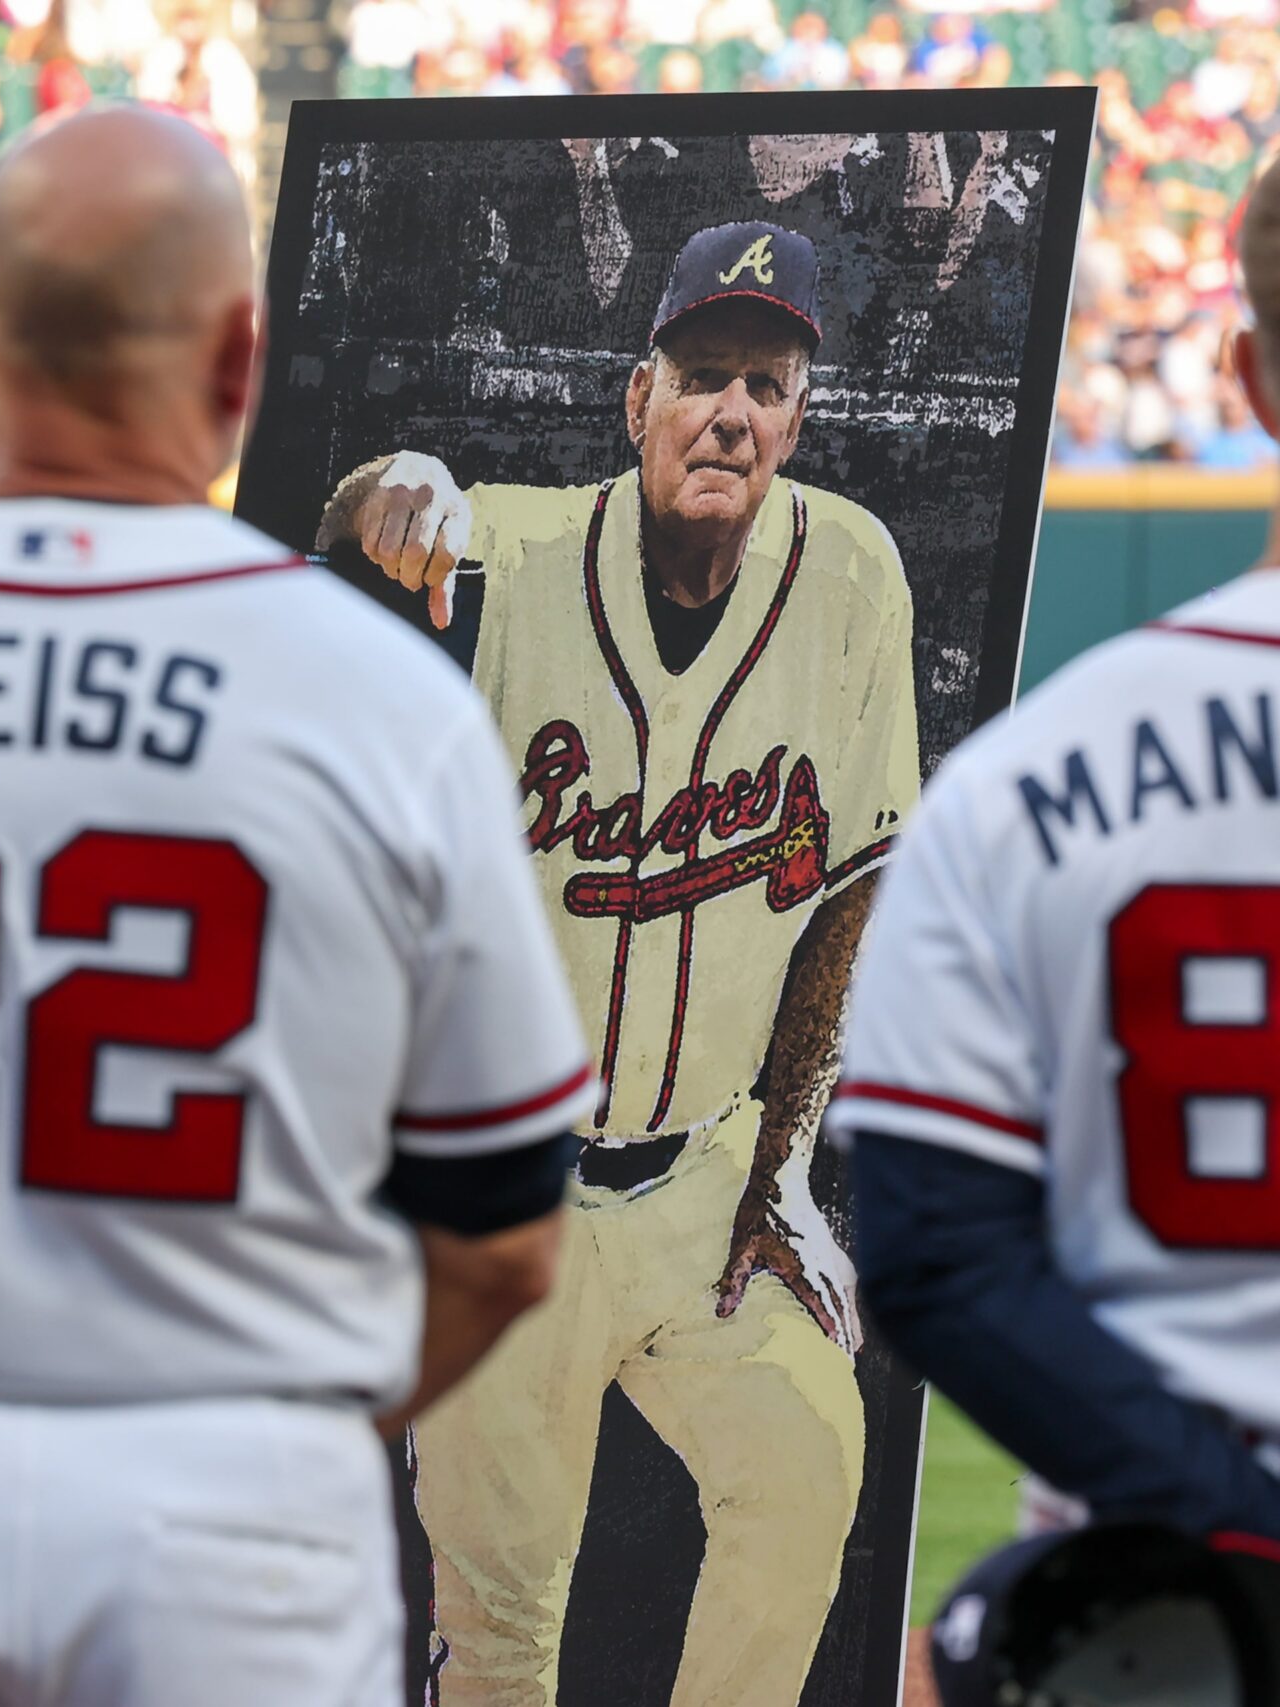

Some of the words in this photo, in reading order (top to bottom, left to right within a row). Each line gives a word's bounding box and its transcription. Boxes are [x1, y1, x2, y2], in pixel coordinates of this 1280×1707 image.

[719, 233, 774, 285] A
[516, 718, 788, 862] Braves
[1019, 693, 1280, 868] MAN
